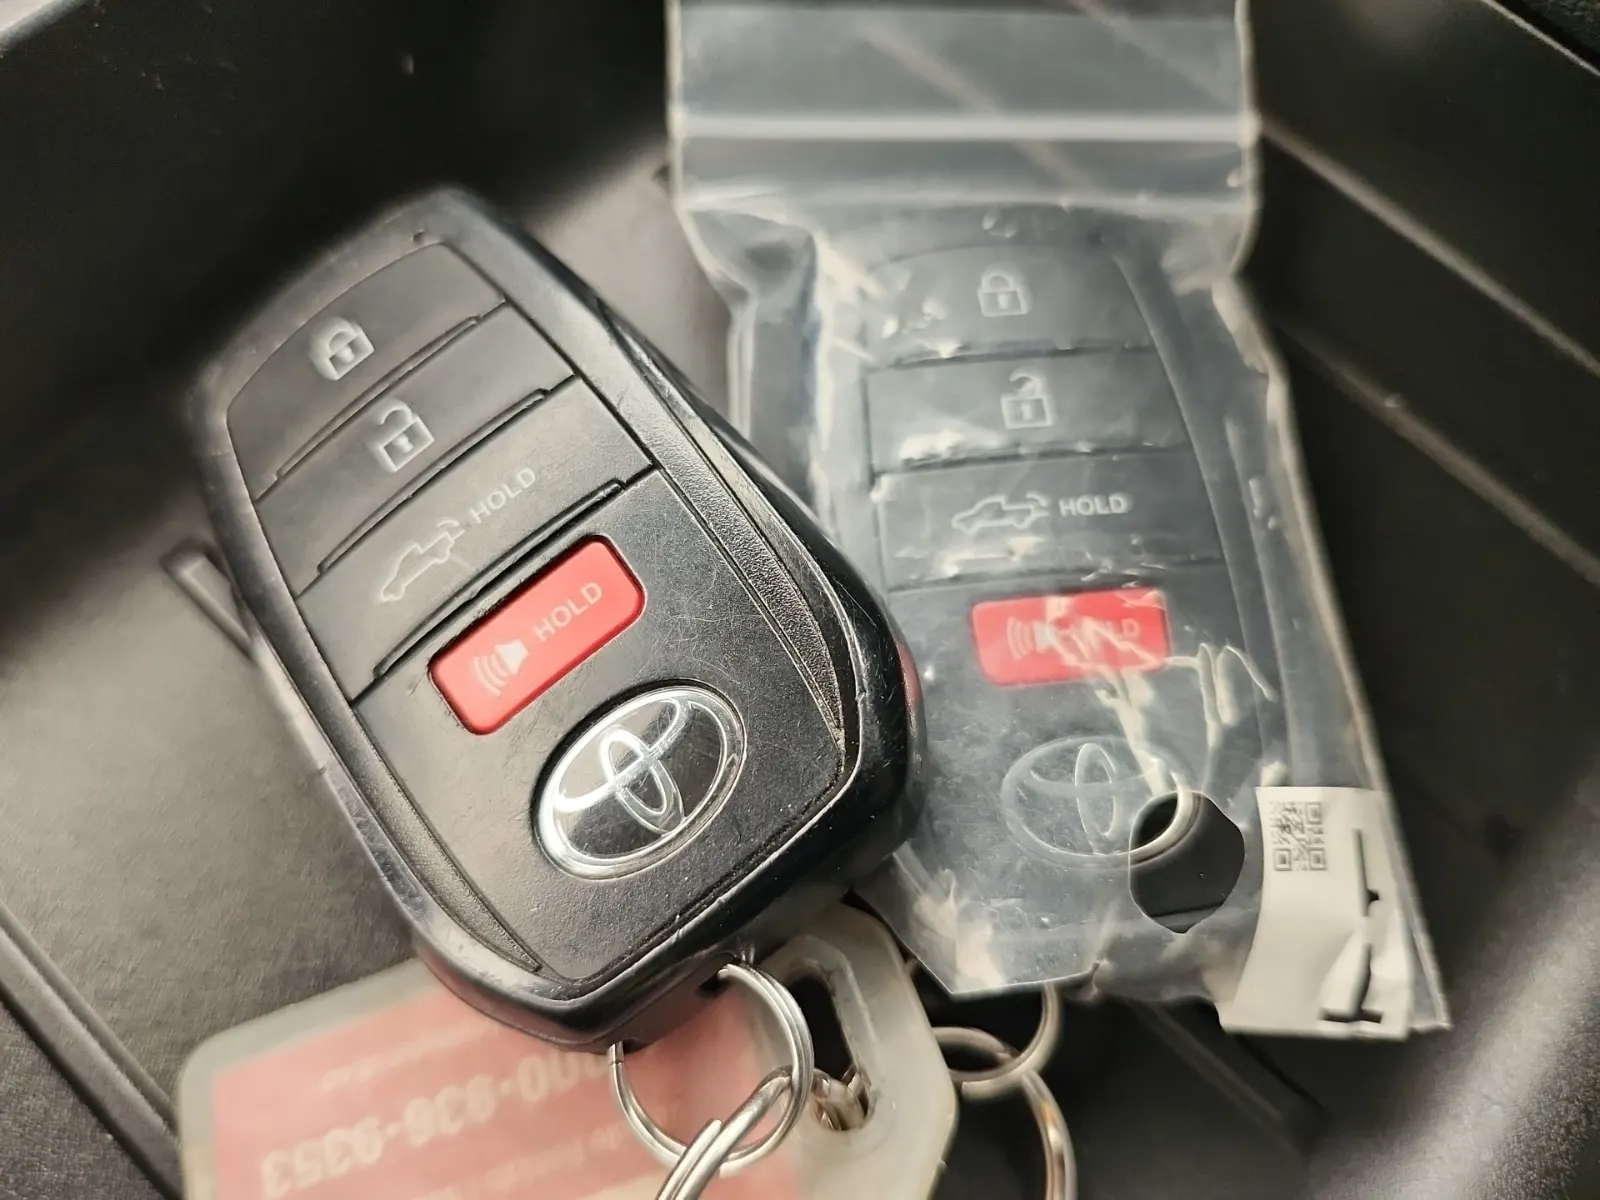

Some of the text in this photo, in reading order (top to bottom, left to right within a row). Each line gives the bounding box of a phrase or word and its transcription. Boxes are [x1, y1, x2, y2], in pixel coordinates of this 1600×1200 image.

[470, 468, 536, 524] HOLD
[1058, 494, 1130, 517] HOLD
[533, 581, 603, 642] HOLD
